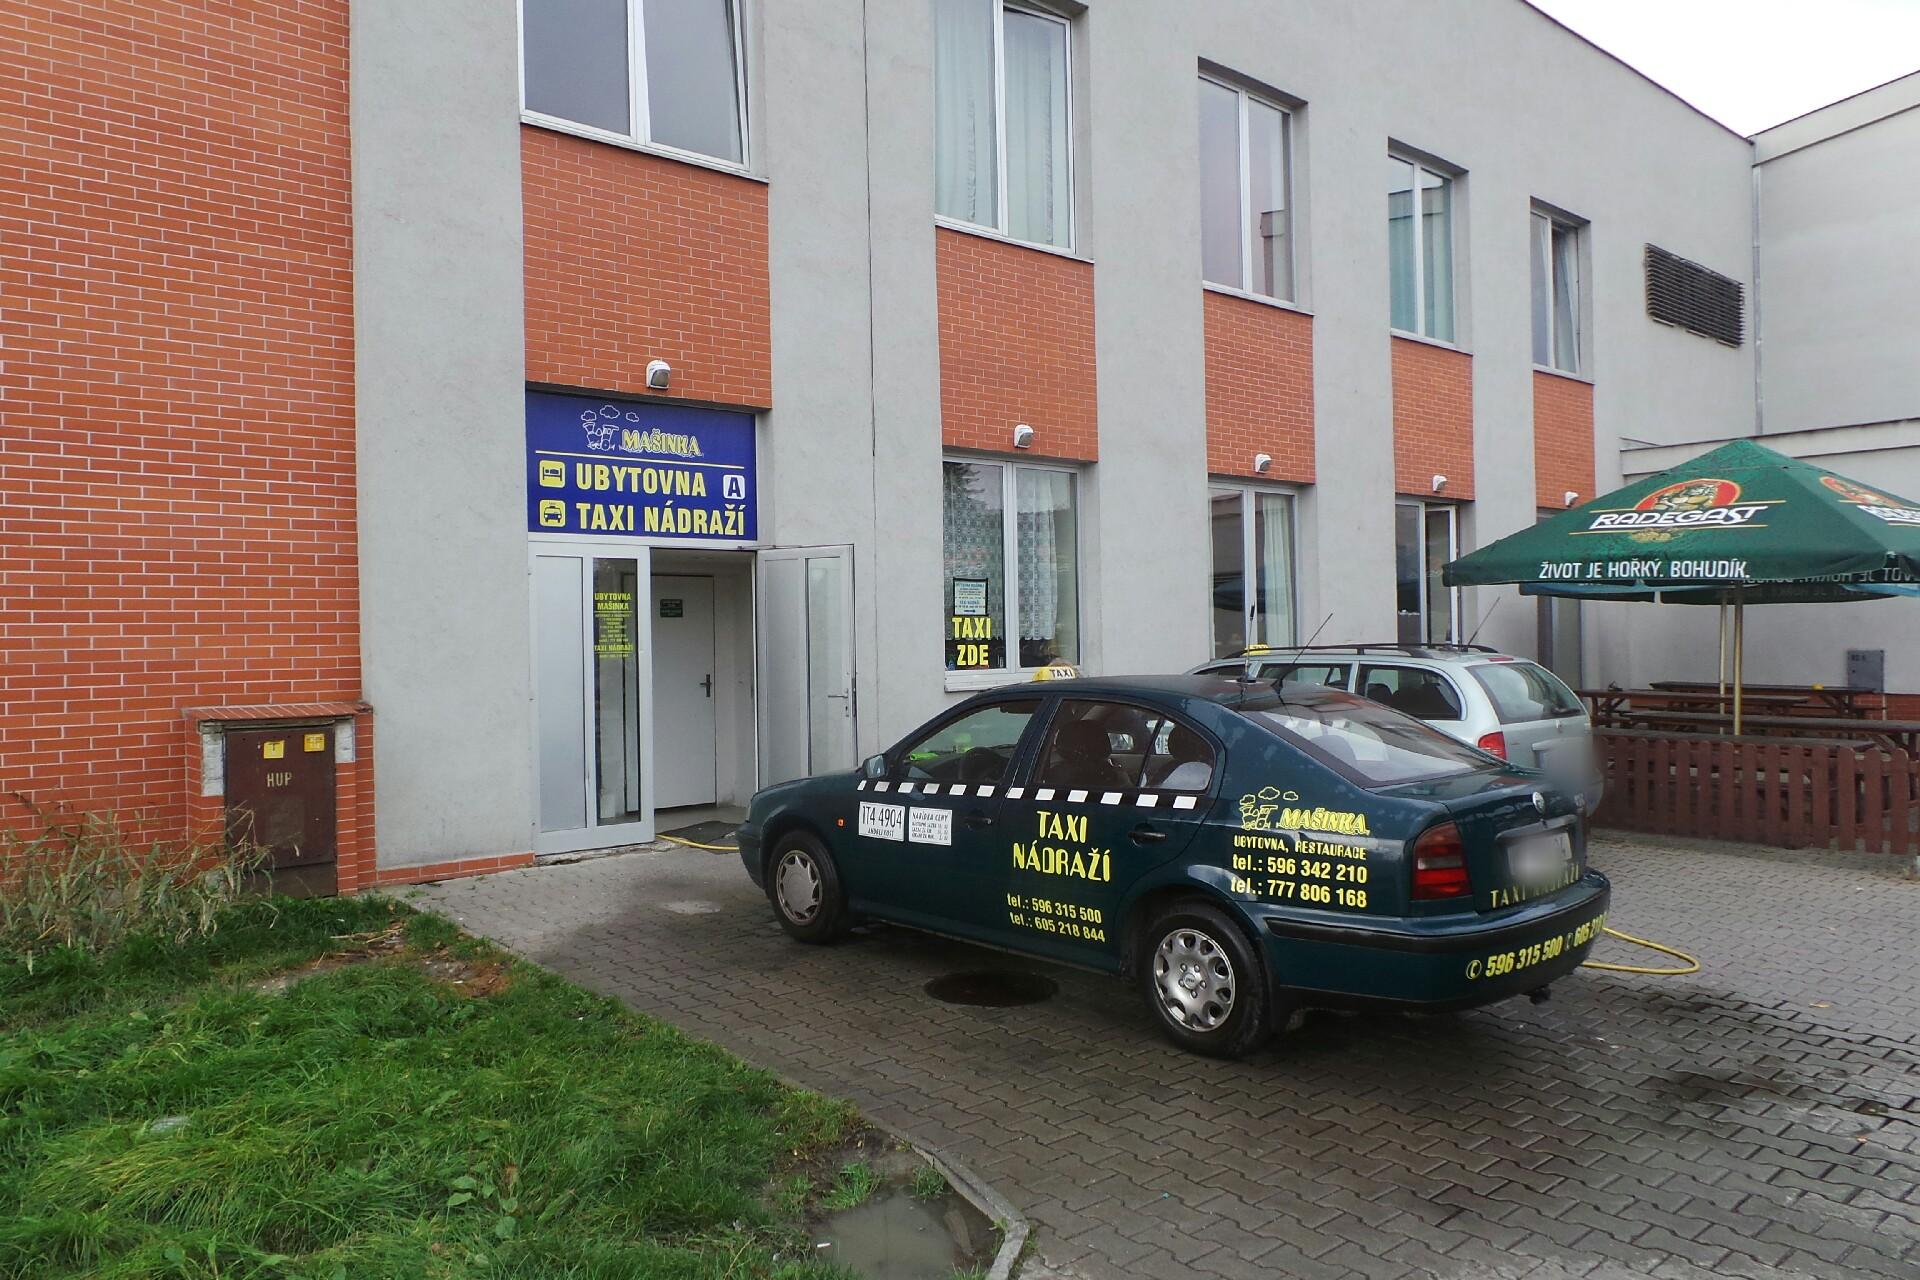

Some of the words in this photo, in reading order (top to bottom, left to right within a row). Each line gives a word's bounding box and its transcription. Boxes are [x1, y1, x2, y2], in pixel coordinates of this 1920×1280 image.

[621, 428, 703, 457] MAŠINKA
[576, 462, 706, 497] UBYTOVNA
[727, 477, 742, 498] A
[576, 503, 634, 531] TAXI
[644, 500, 745, 536] NÁDRAŽÍ
[1589, 506, 1768, 530] RADEGAST
[1538, 561, 1582, 579] ŽIVOT
[1586, 562, 1603, 578] JE
[1608, 558, 1664, 578] HOŘKÝ.
[1670, 558, 1750, 579] BOHUDÍK.
[594, 592, 631, 601] UBYTOVNA
[952, 617, 991, 639] TAXI
[957, 644, 989, 666] ZDE
[1049, 669, 1073, 678] TAXI
[266, 772, 292, 787] HUP
[862, 805, 876, 825] 1T4
[878, 808, 902, 829] 4904
[1037, 810, 1088, 843] TAXI
[1279, 807, 1369, 836] MAŠINKA
[1013, 840, 1111, 882] NÁDRAŽÍ
[1233, 835, 1289, 853] UBYTOVNA,
[1295, 840, 1367, 861] RESTAURACE
[1232, 853, 1263, 872] tel.:
[1267, 856, 1296, 875] 596
[1300, 860, 1331, 880] 342
[1335, 864, 1368, 884] 210
[1230, 876, 1263, 895] tel.:
[1267, 879, 1296, 899] 777
[1300, 884, 1331, 903] 806
[1335, 888, 1367, 908] 168
[1007, 893, 1029, 909] tel.:
[1031, 897, 1052, 914] 596
[1055, 902, 1077, 919] 315
[1080, 906, 1102, 924] 500
[1009, 911, 1033, 928] tel.:
[1034, 916, 1056, 932] 605
[1059, 921, 1080, 937] 218
[1083, 926, 1106, 943] 844
[1485, 953, 1515, 978] 596
[1516, 943, 1541, 970] 315
[1543, 935, 1564, 960] 500
